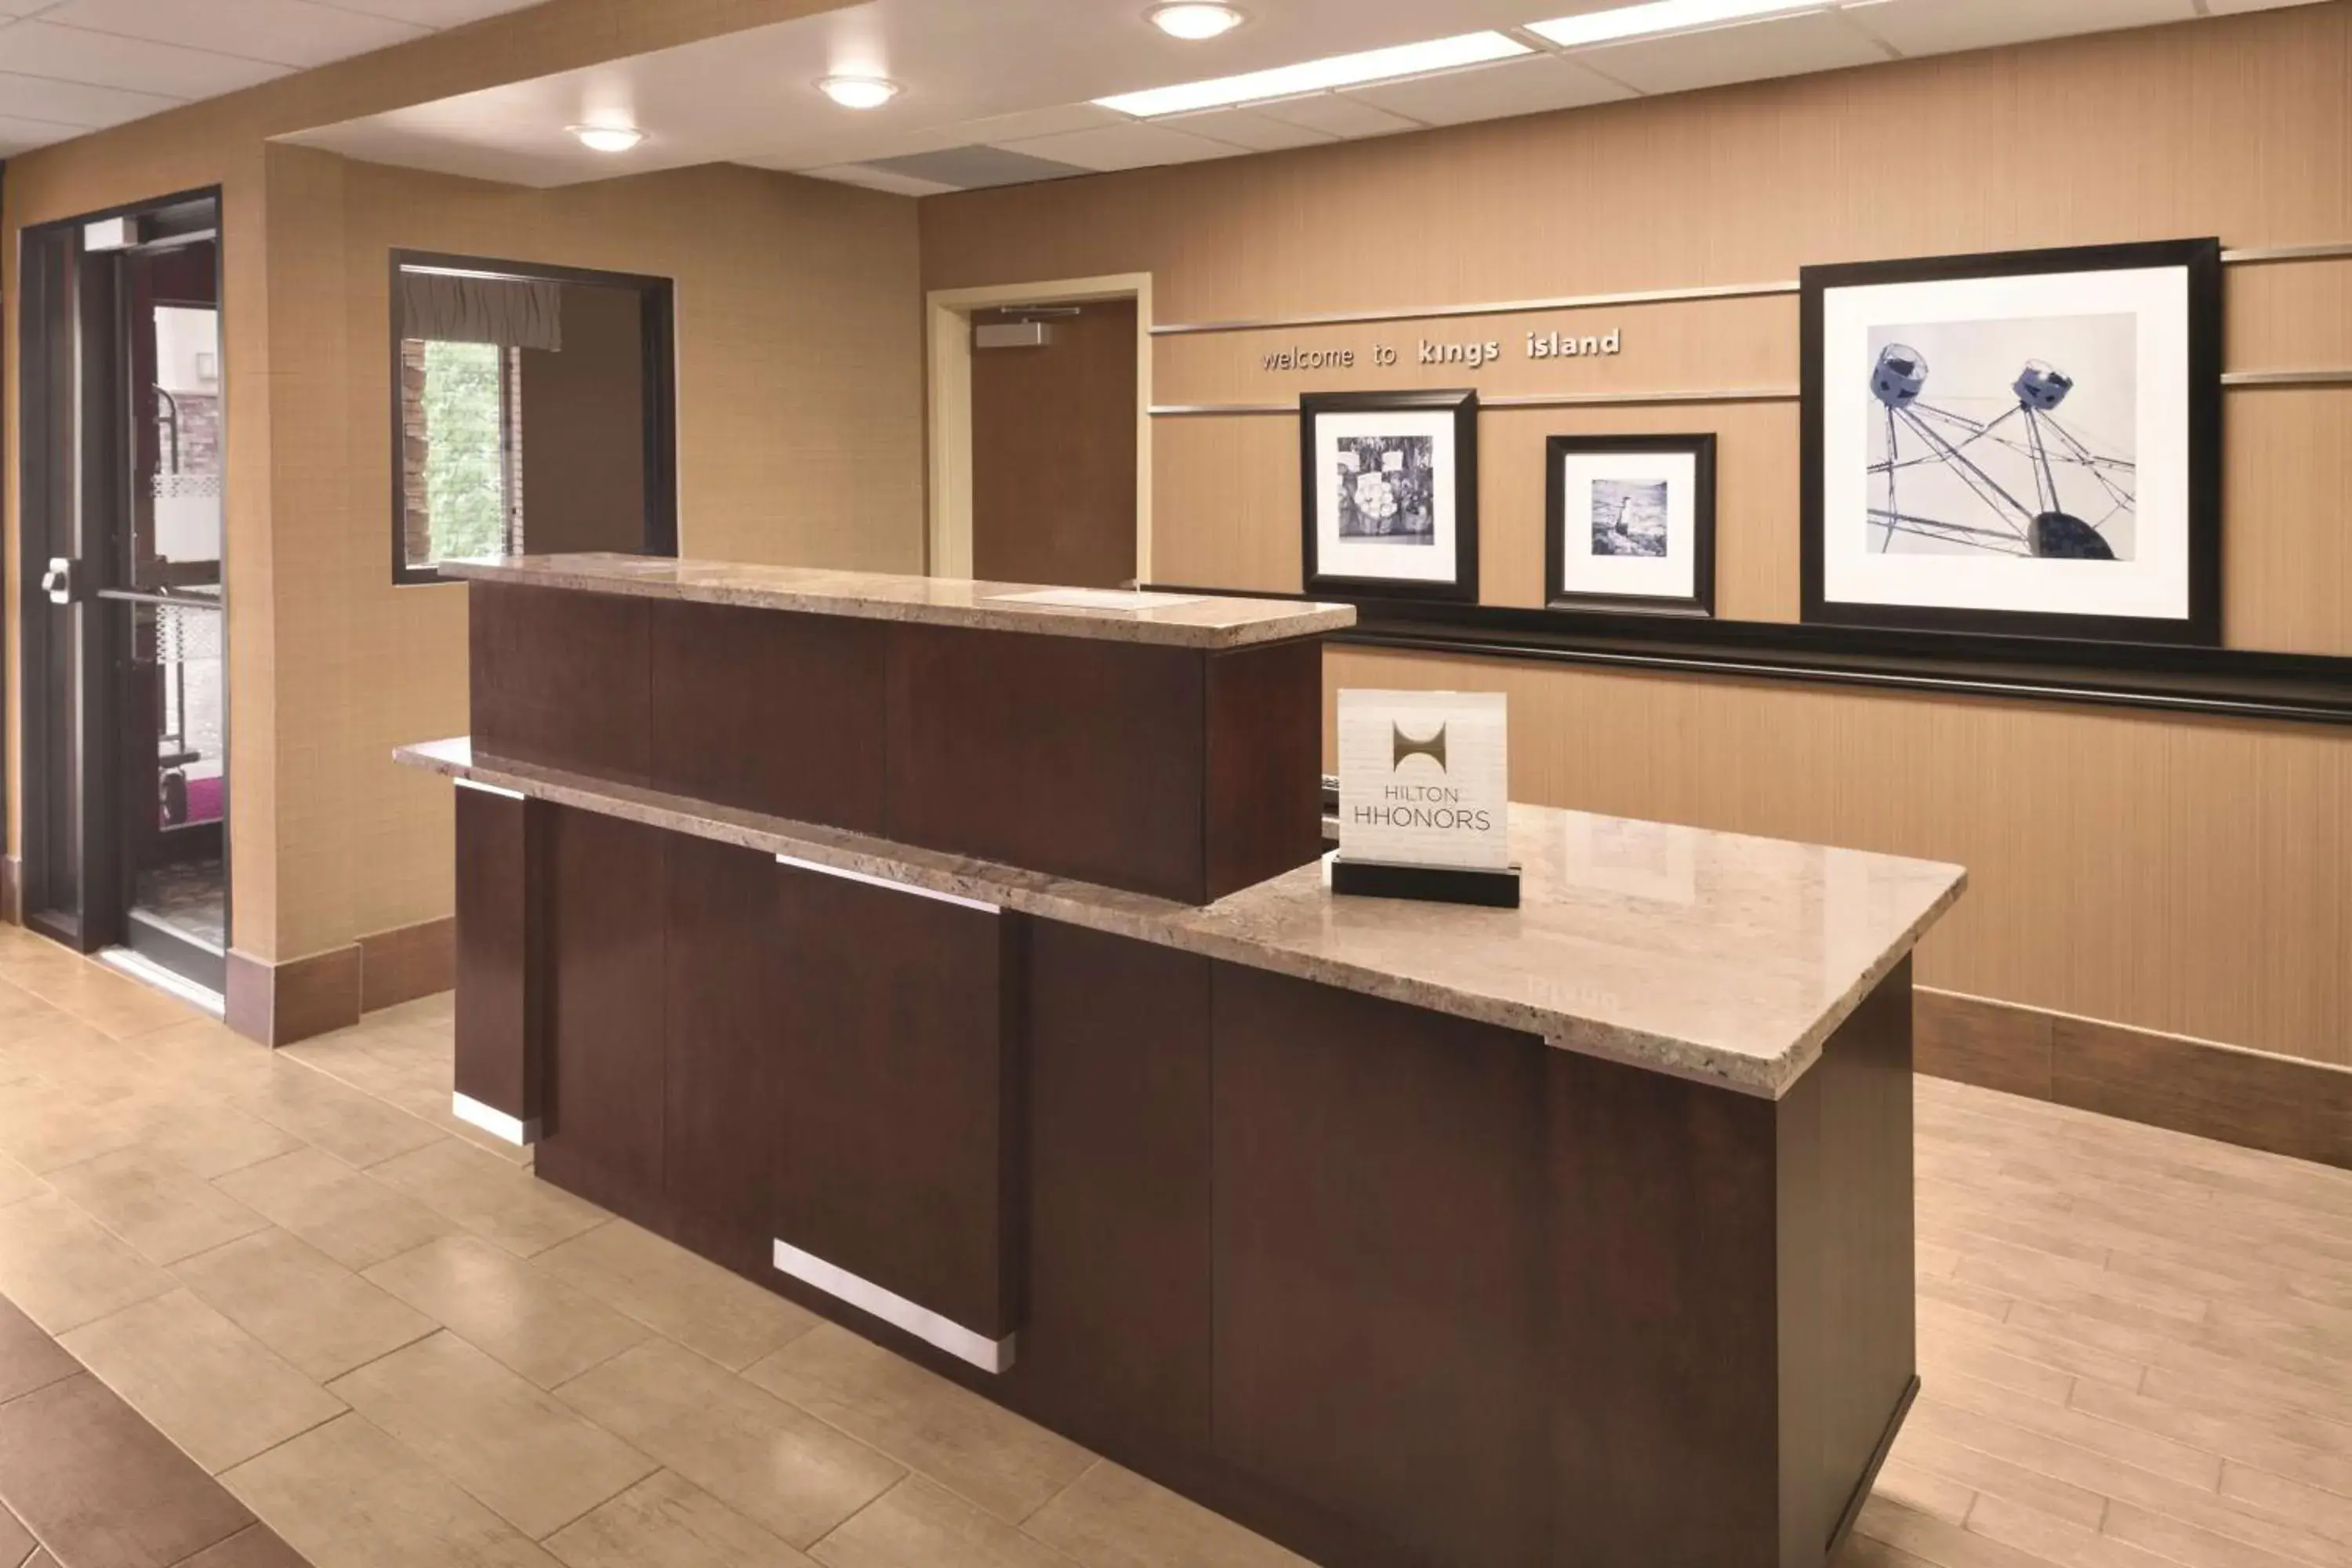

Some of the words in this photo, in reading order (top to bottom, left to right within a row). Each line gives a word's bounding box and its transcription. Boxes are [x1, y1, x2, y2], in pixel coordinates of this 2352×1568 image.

[1263, 346, 1355, 370] welcome
[1373, 344, 1397, 365] to
[1417, 339, 1500, 368] kings
[1526, 328, 1621, 358] island
[1385, 785, 1459, 803] HILTON
[1354, 806, 1490, 831] HHONORS
